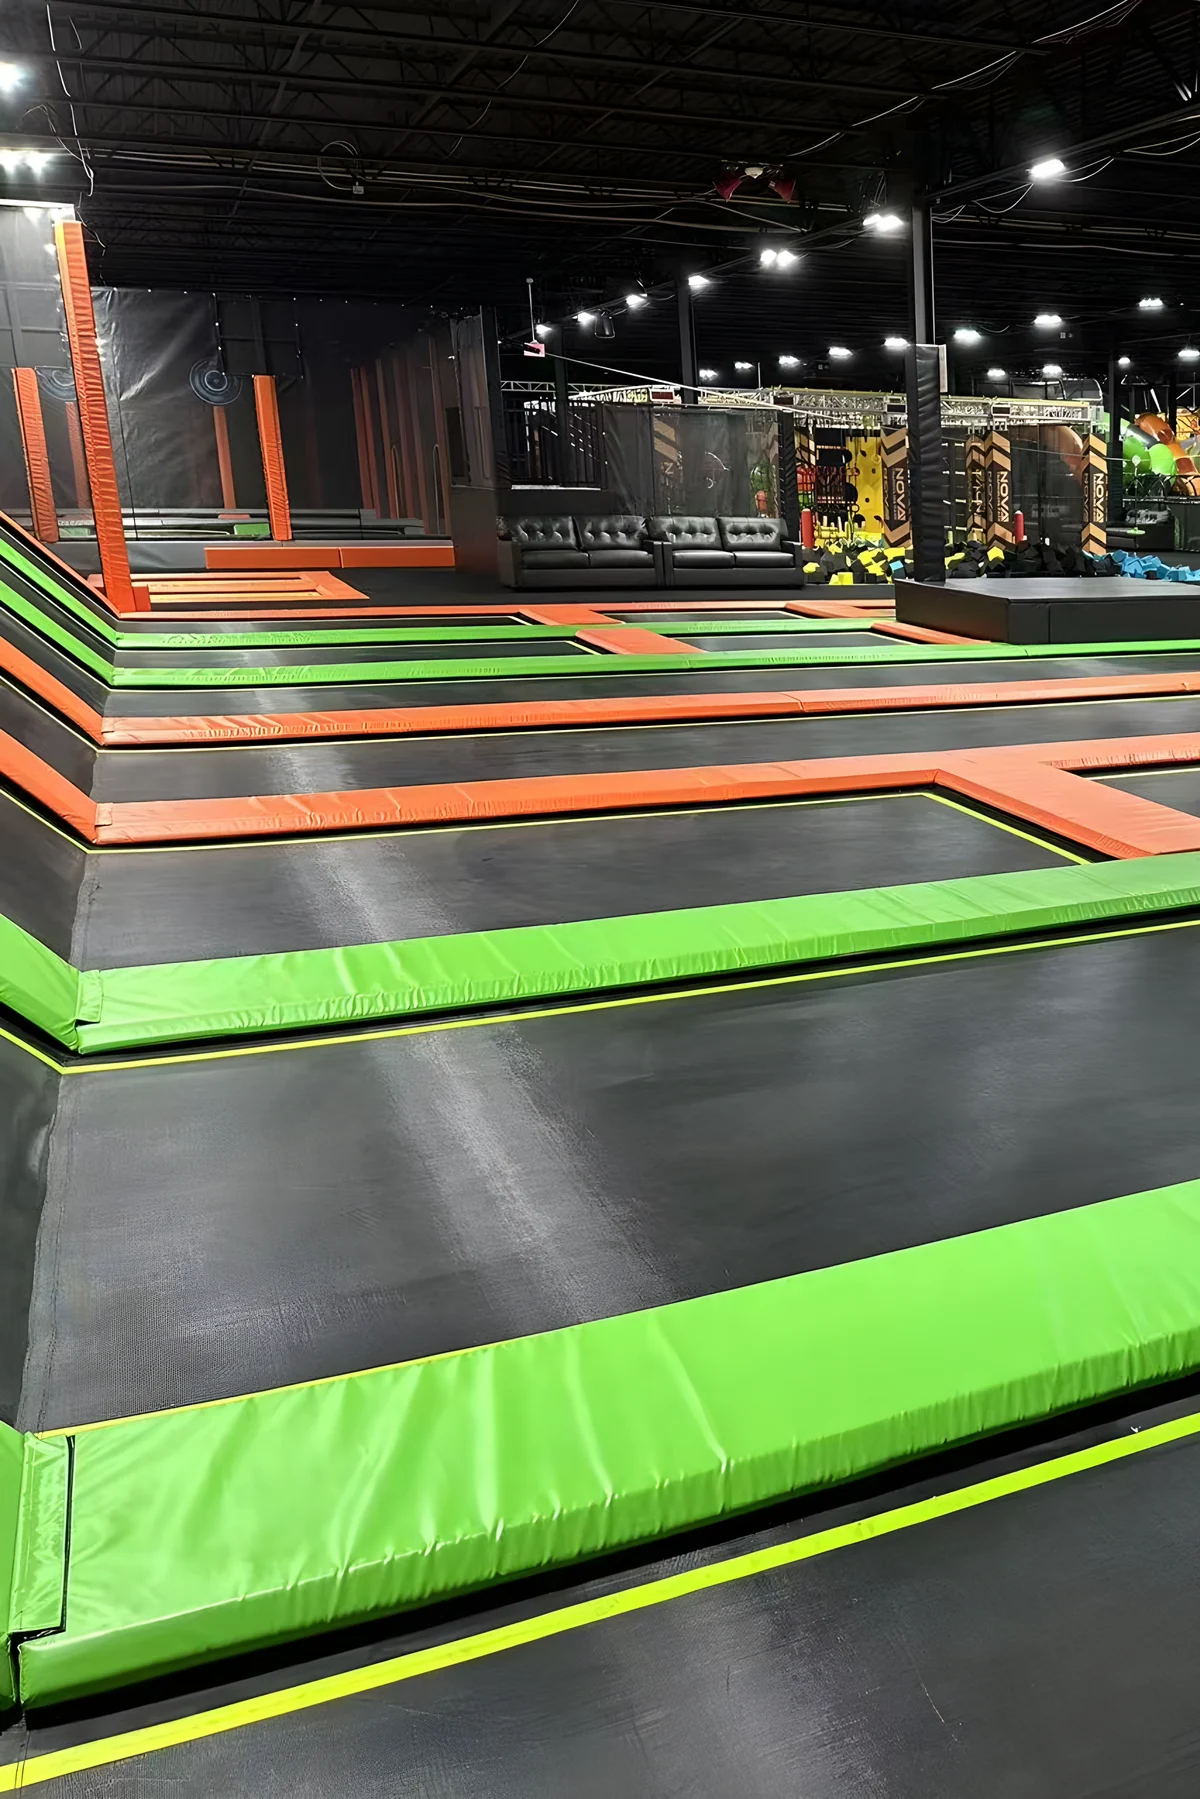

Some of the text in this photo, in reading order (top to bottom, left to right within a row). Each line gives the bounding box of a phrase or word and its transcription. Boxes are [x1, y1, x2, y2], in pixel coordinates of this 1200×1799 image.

[895, 467, 906, 521] NOVA
[1000, 471, 1009, 522] NOVA
[1096, 472, 1105, 523] NOVA
